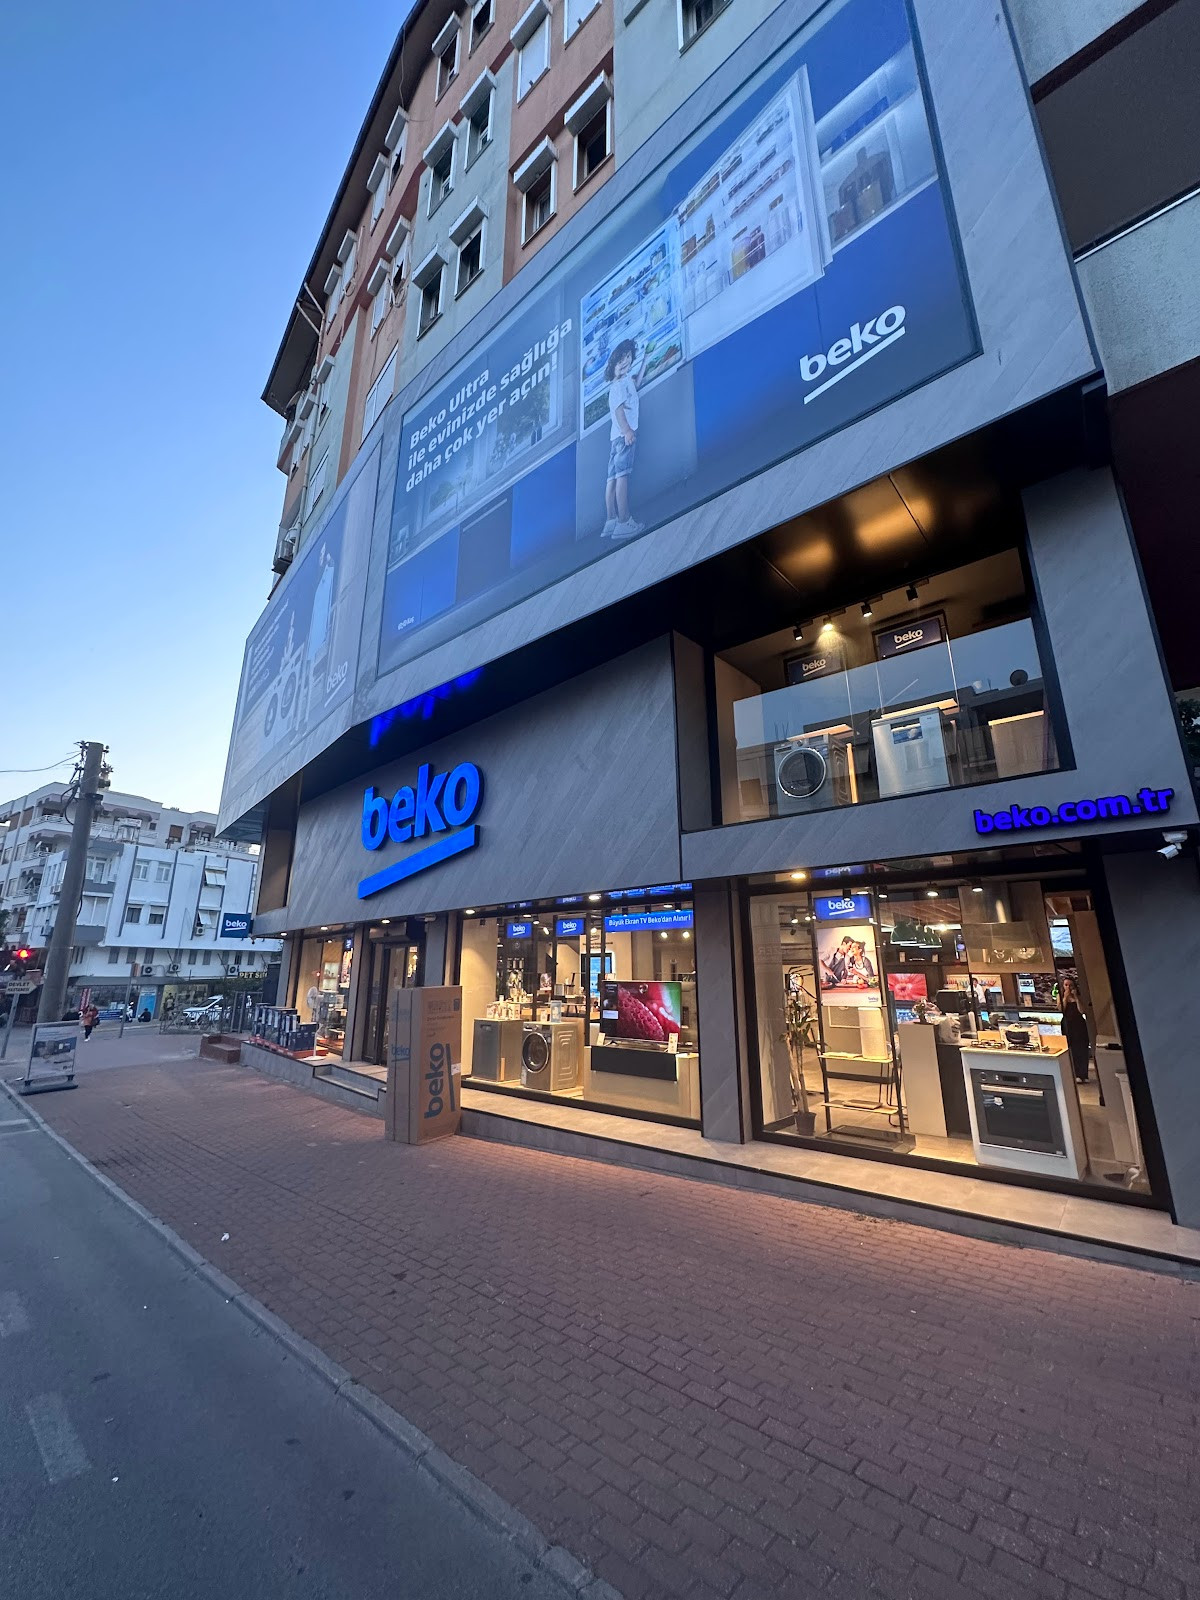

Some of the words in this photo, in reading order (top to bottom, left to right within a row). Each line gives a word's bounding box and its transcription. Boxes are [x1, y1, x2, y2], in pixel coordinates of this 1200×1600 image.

[799, 305, 906, 382] beko
[407, 446, 426, 472] ile
[428, 384, 497, 453] evinizde
[500, 318, 572, 391] sağlığa
[409, 408, 447, 450] Beko
[449, 368, 489, 413] Ultra
[405, 453, 442, 493] daha
[444, 425, 474, 464] çok
[475, 397, 507, 439] yer
[509, 350, 559, 407] açın!
[893, 628, 924, 644] beko
[326, 660, 349, 694] beko
[802, 657, 827, 672] beko
[361, 762, 483, 852] beko
[974, 788, 1173, 834] beko.com.tr
[647, 915, 673, 924] Beko'dan
[827, 899, 856, 911] beko
[225, 919, 248, 928] beko
[512, 924, 526, 932] beko
[562, 921, 577, 929] beko
[424, 1042, 446, 1119] beko
